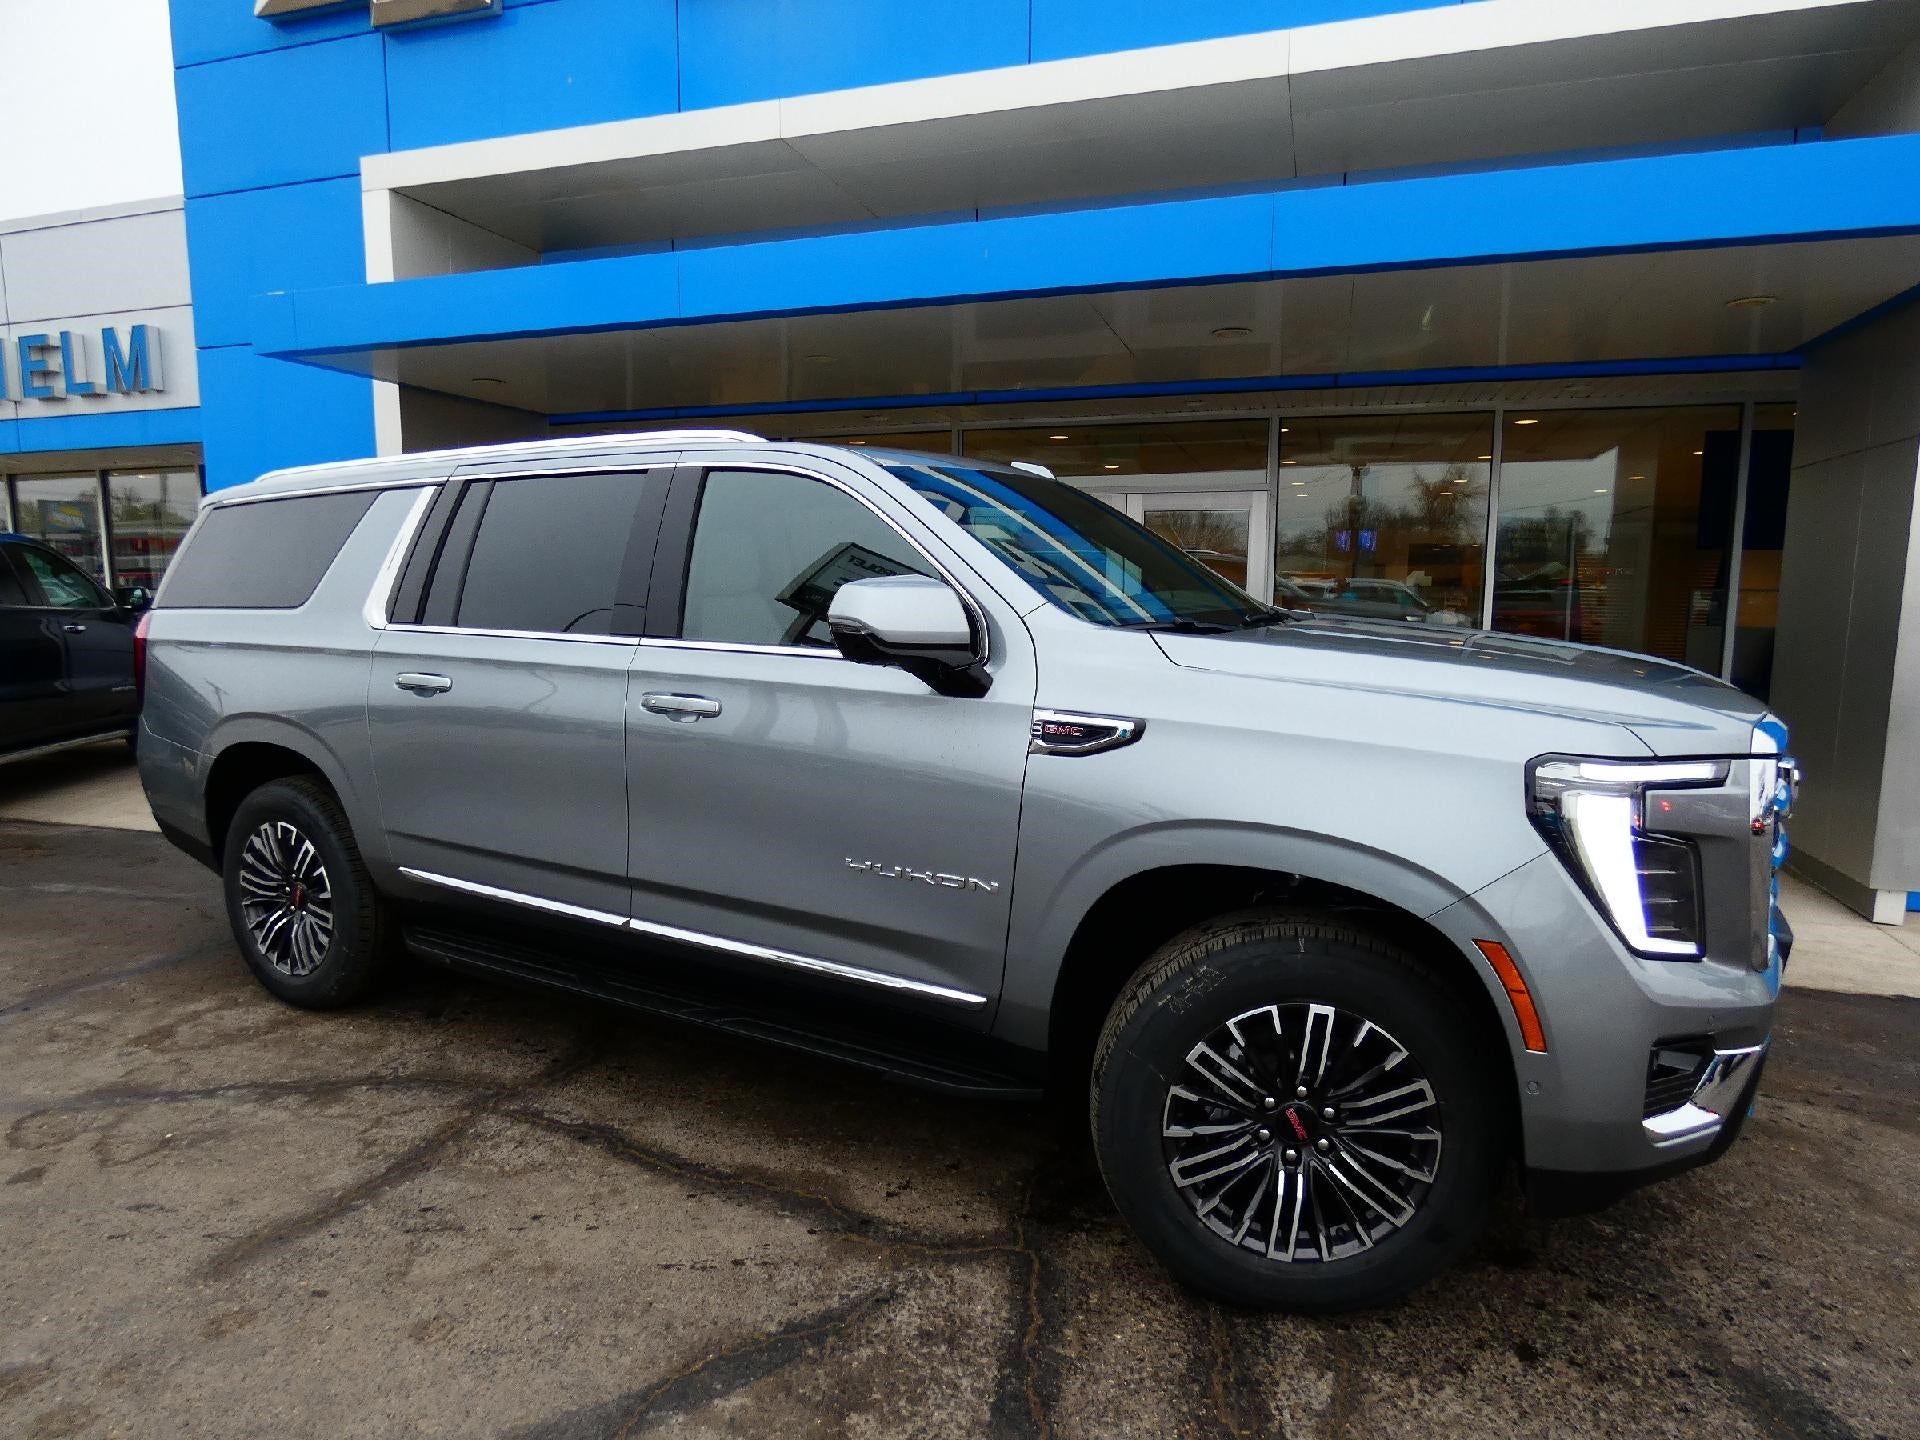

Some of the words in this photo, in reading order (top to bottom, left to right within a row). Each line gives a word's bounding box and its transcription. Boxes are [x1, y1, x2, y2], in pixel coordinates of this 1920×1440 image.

[0, 324, 158, 399] ELM
[1044, 724, 1084, 736] GMC
[844, 857, 999, 895] YUKON
